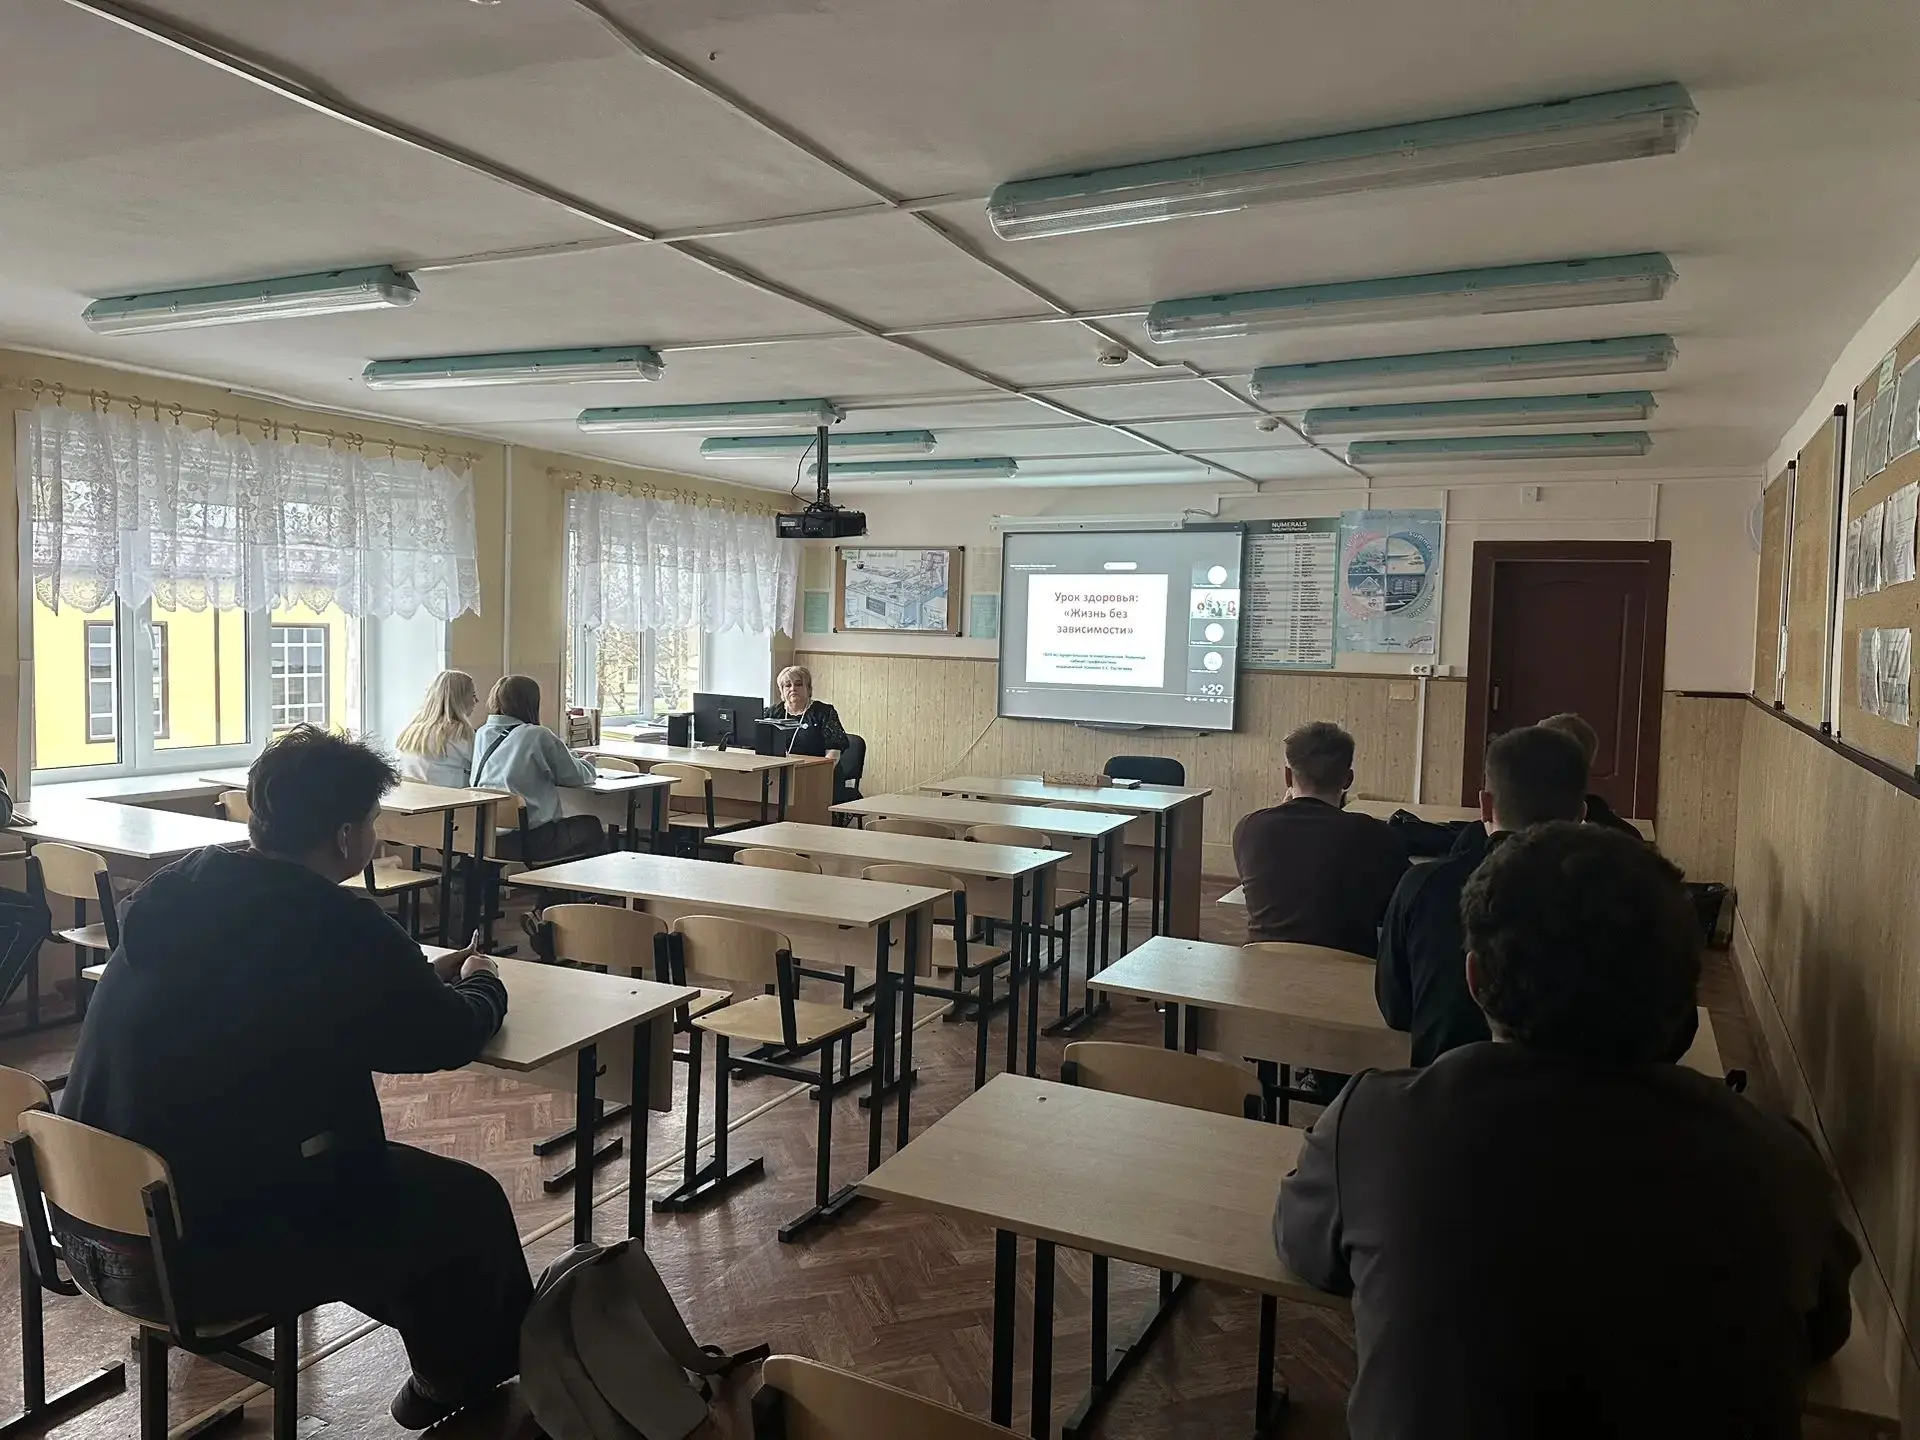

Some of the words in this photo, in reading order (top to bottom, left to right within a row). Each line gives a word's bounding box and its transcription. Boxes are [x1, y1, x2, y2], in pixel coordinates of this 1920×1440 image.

[1054, 592, 1080, 604] Урок
[1083, 594, 1139, 604] здоровья:
[1064, 608, 1106, 618] «Жизнь
[1109, 608, 1128, 619] без
[1056, 625, 1134, 635] зависимости»
[1200, 684, 1224, 696] +29
